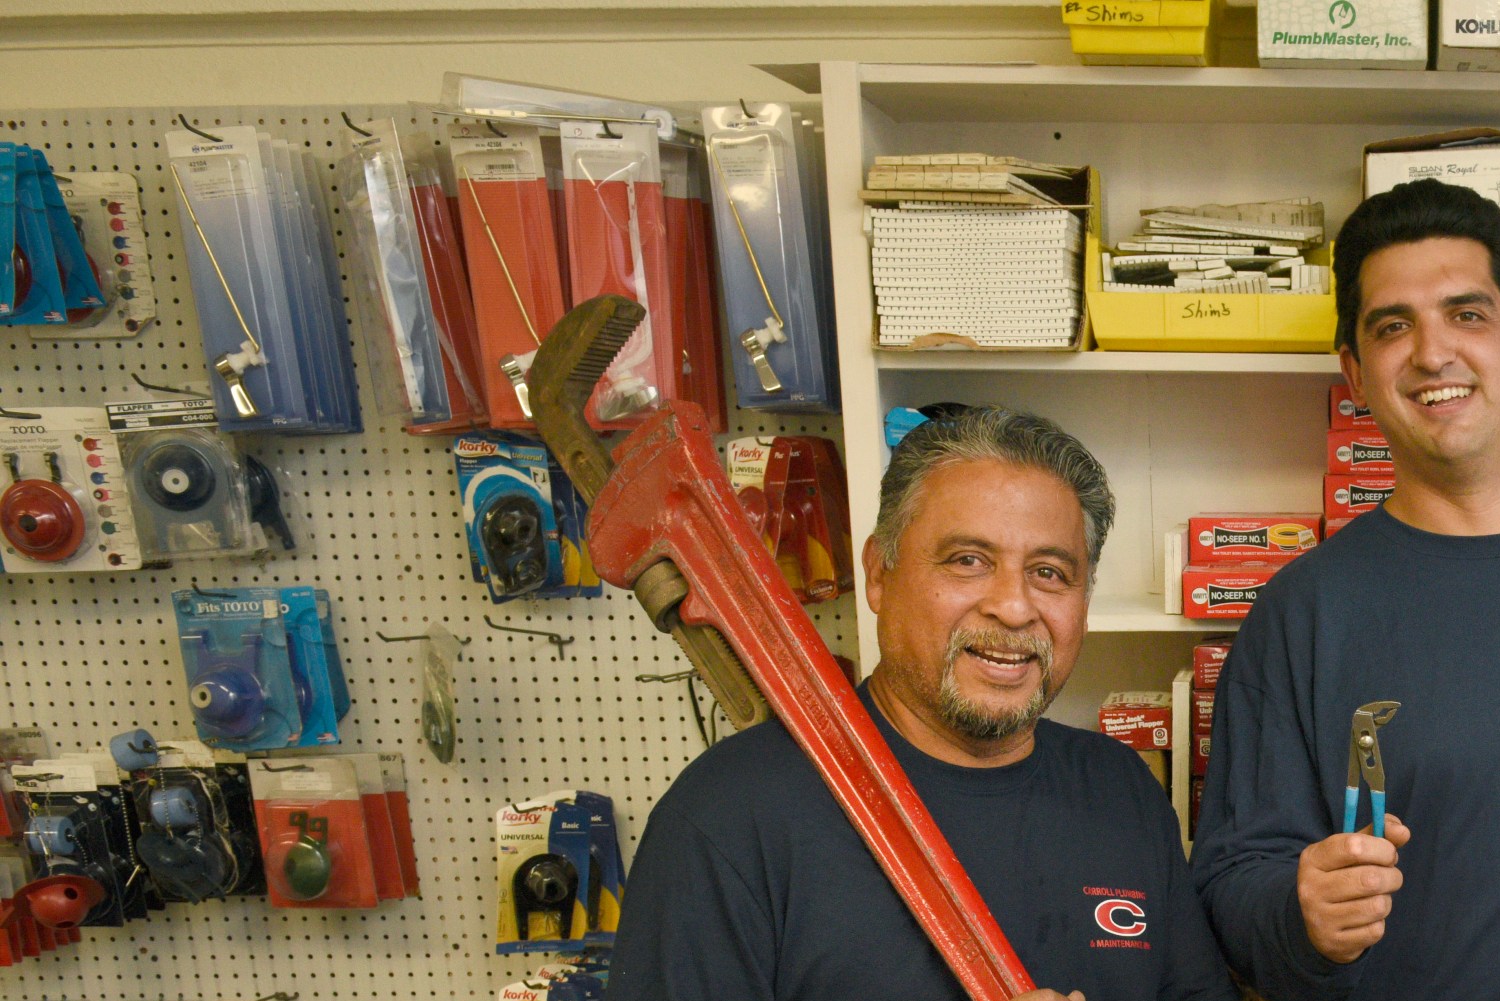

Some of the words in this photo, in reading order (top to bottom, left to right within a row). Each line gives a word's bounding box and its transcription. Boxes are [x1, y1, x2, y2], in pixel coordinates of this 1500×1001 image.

[1272, 31, 1380, 48] PlumbMaster,
[1384, 33, 1412, 46] Inc.
[117, 404, 154, 412] FLAPPER
[10, 425, 46, 435] TOTO
[458, 439, 497, 455] korky
[738, 447, 763, 460] korky
[734, 466, 763, 474] UNIVERSAL
[1249, 535, 1261, 543] NO.
[196, 602, 220, 614] Fits
[223, 601, 259, 613] TOTO
[501, 811, 542, 824] korky
[1094, 899, 1147, 937] C
